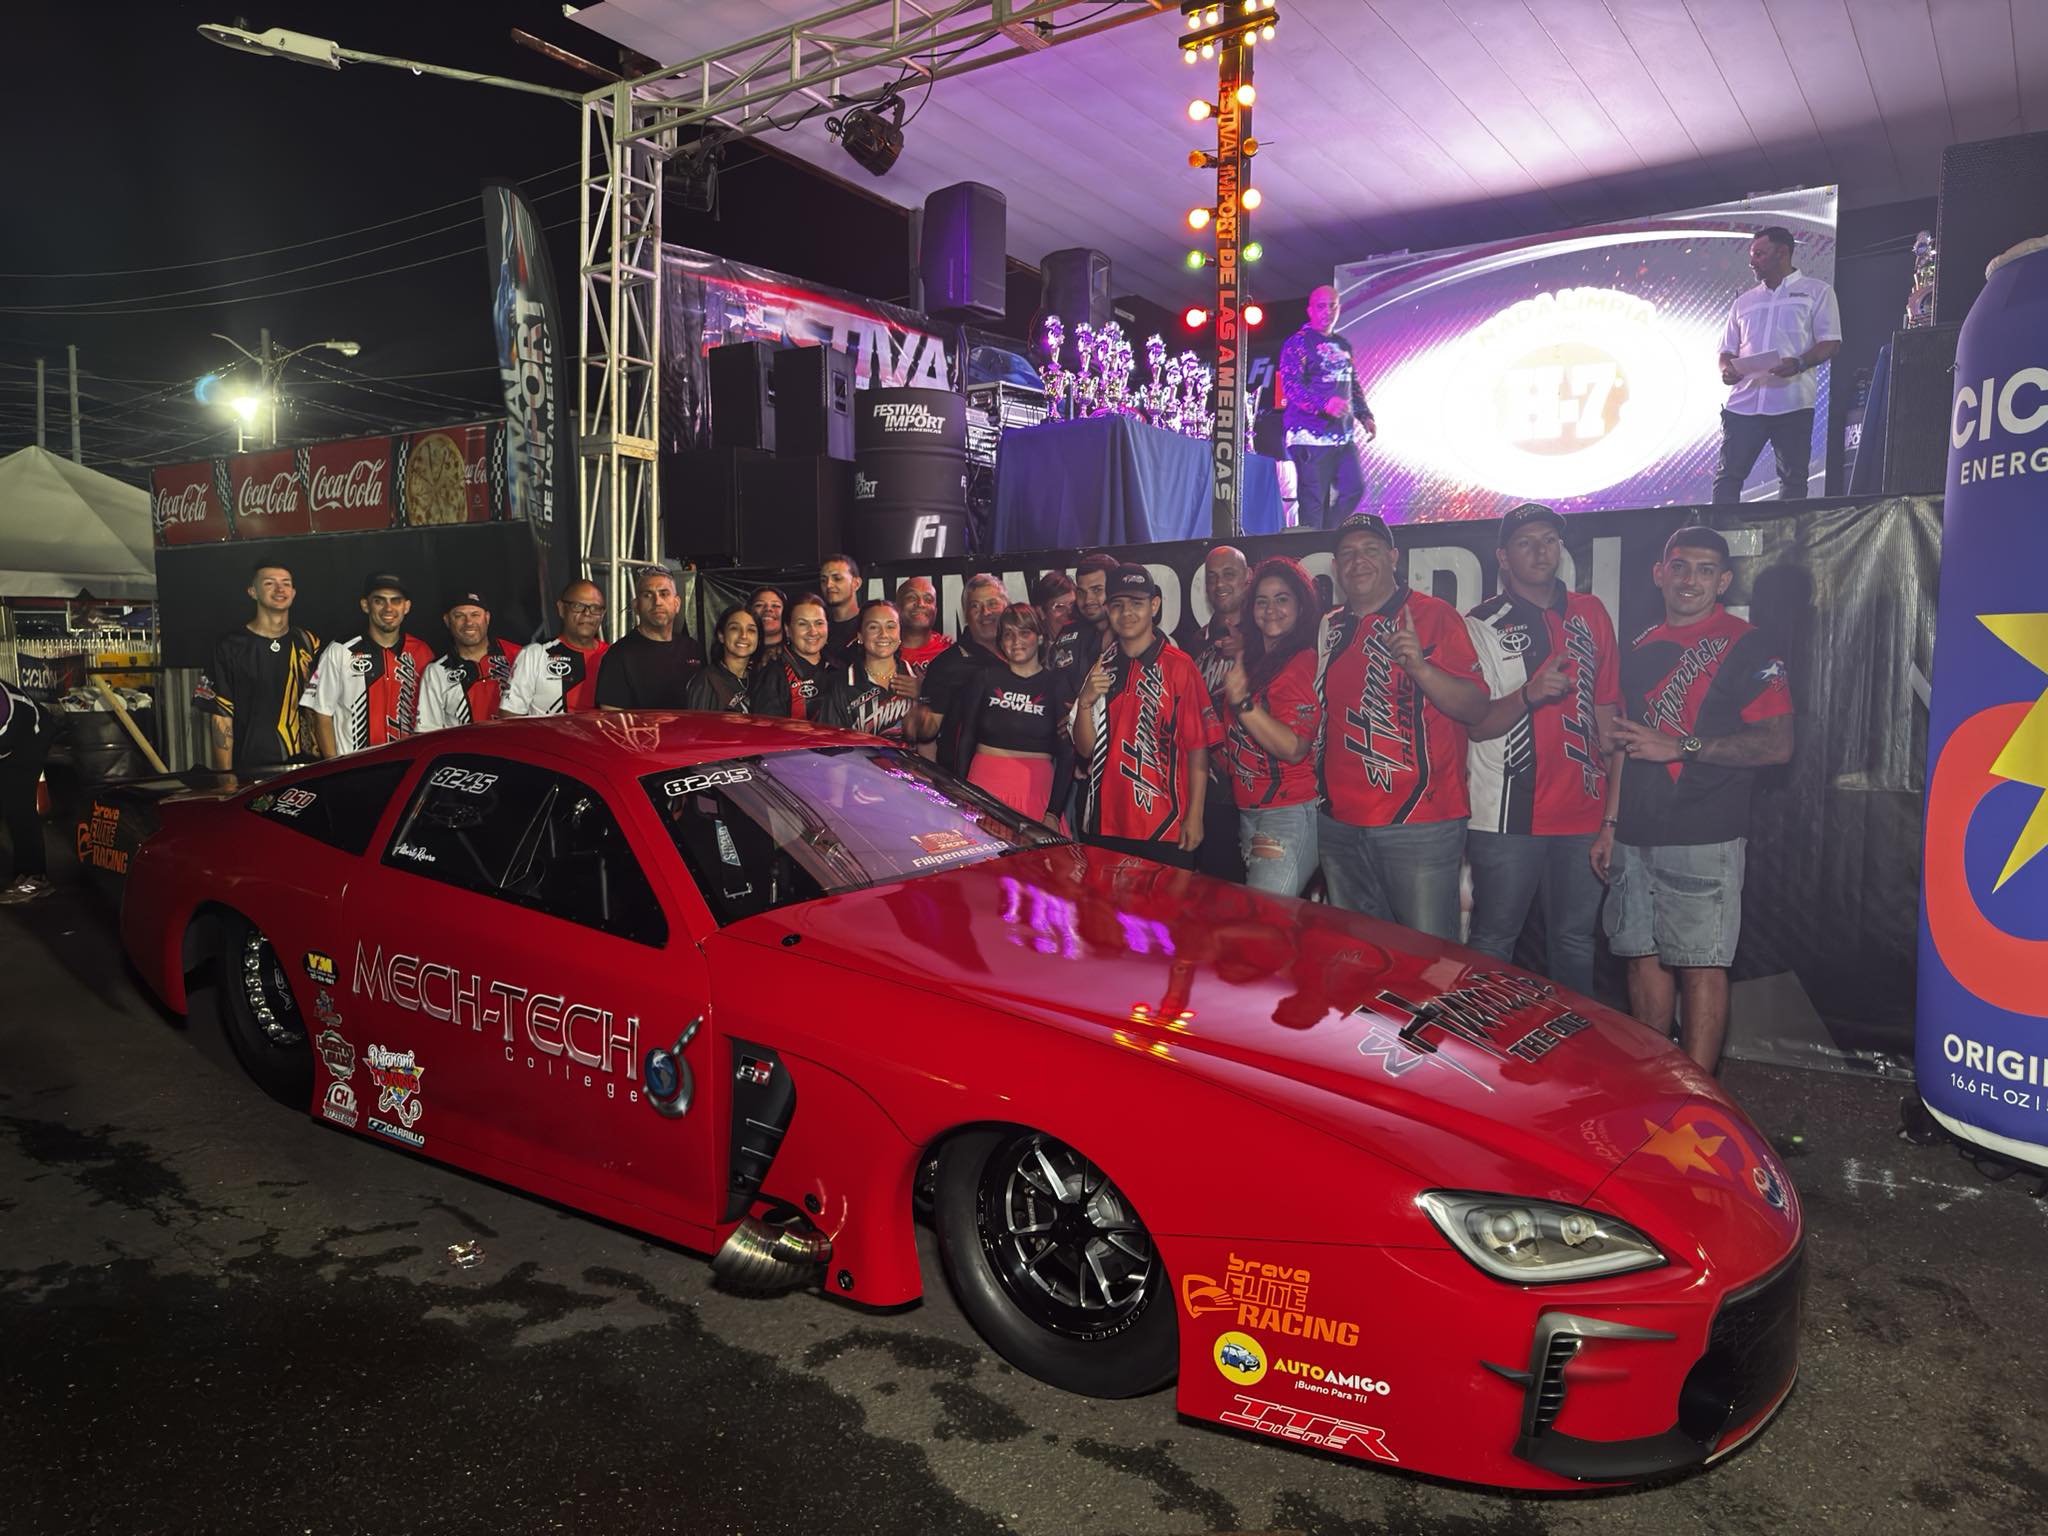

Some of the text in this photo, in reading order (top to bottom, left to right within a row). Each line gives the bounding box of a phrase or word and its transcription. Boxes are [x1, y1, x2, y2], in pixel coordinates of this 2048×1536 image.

[1217, 165, 1236, 242] IMPORT
[1219, 249, 1236, 284] DE
[1219, 290, 1236, 340] LAS
[873, 403, 930, 418] FESTIVAL
[884, 414, 946, 429] IMPORT
[1215, 346, 1235, 500] AMERICAS
[1952, 367, 2048, 449] CIC
[310, 458, 387, 511] Coca-Cola
[1960, 447, 2048, 485] ENERG
[238, 470, 299, 516] Coca-Cola
[544, 492, 553, 521] DE
[988, 697, 1047, 716] POWER
[1003, 691, 1032, 704] GIRL
[430, 766, 498, 796] 8245
[664, 767, 752, 797] 8245
[352, 939, 640, 1081] MECH-TECH
[1506, 1011, 1593, 1064] THE ONE
[1944, 1034, 2048, 1087] ORIGI
[1950, 1073, 2030, 1108] 16.6 FL OZ
[386, 1123, 425, 1145] CARRILLO
[1227, 1252, 1311, 1283] brava
[1224, 1271, 1308, 1313] ELITE
[1237, 1303, 1360, 1347] RACING
[1331, 1388, 1352, 1401] Para
[1220, 1394, 1400, 1463] ITR
